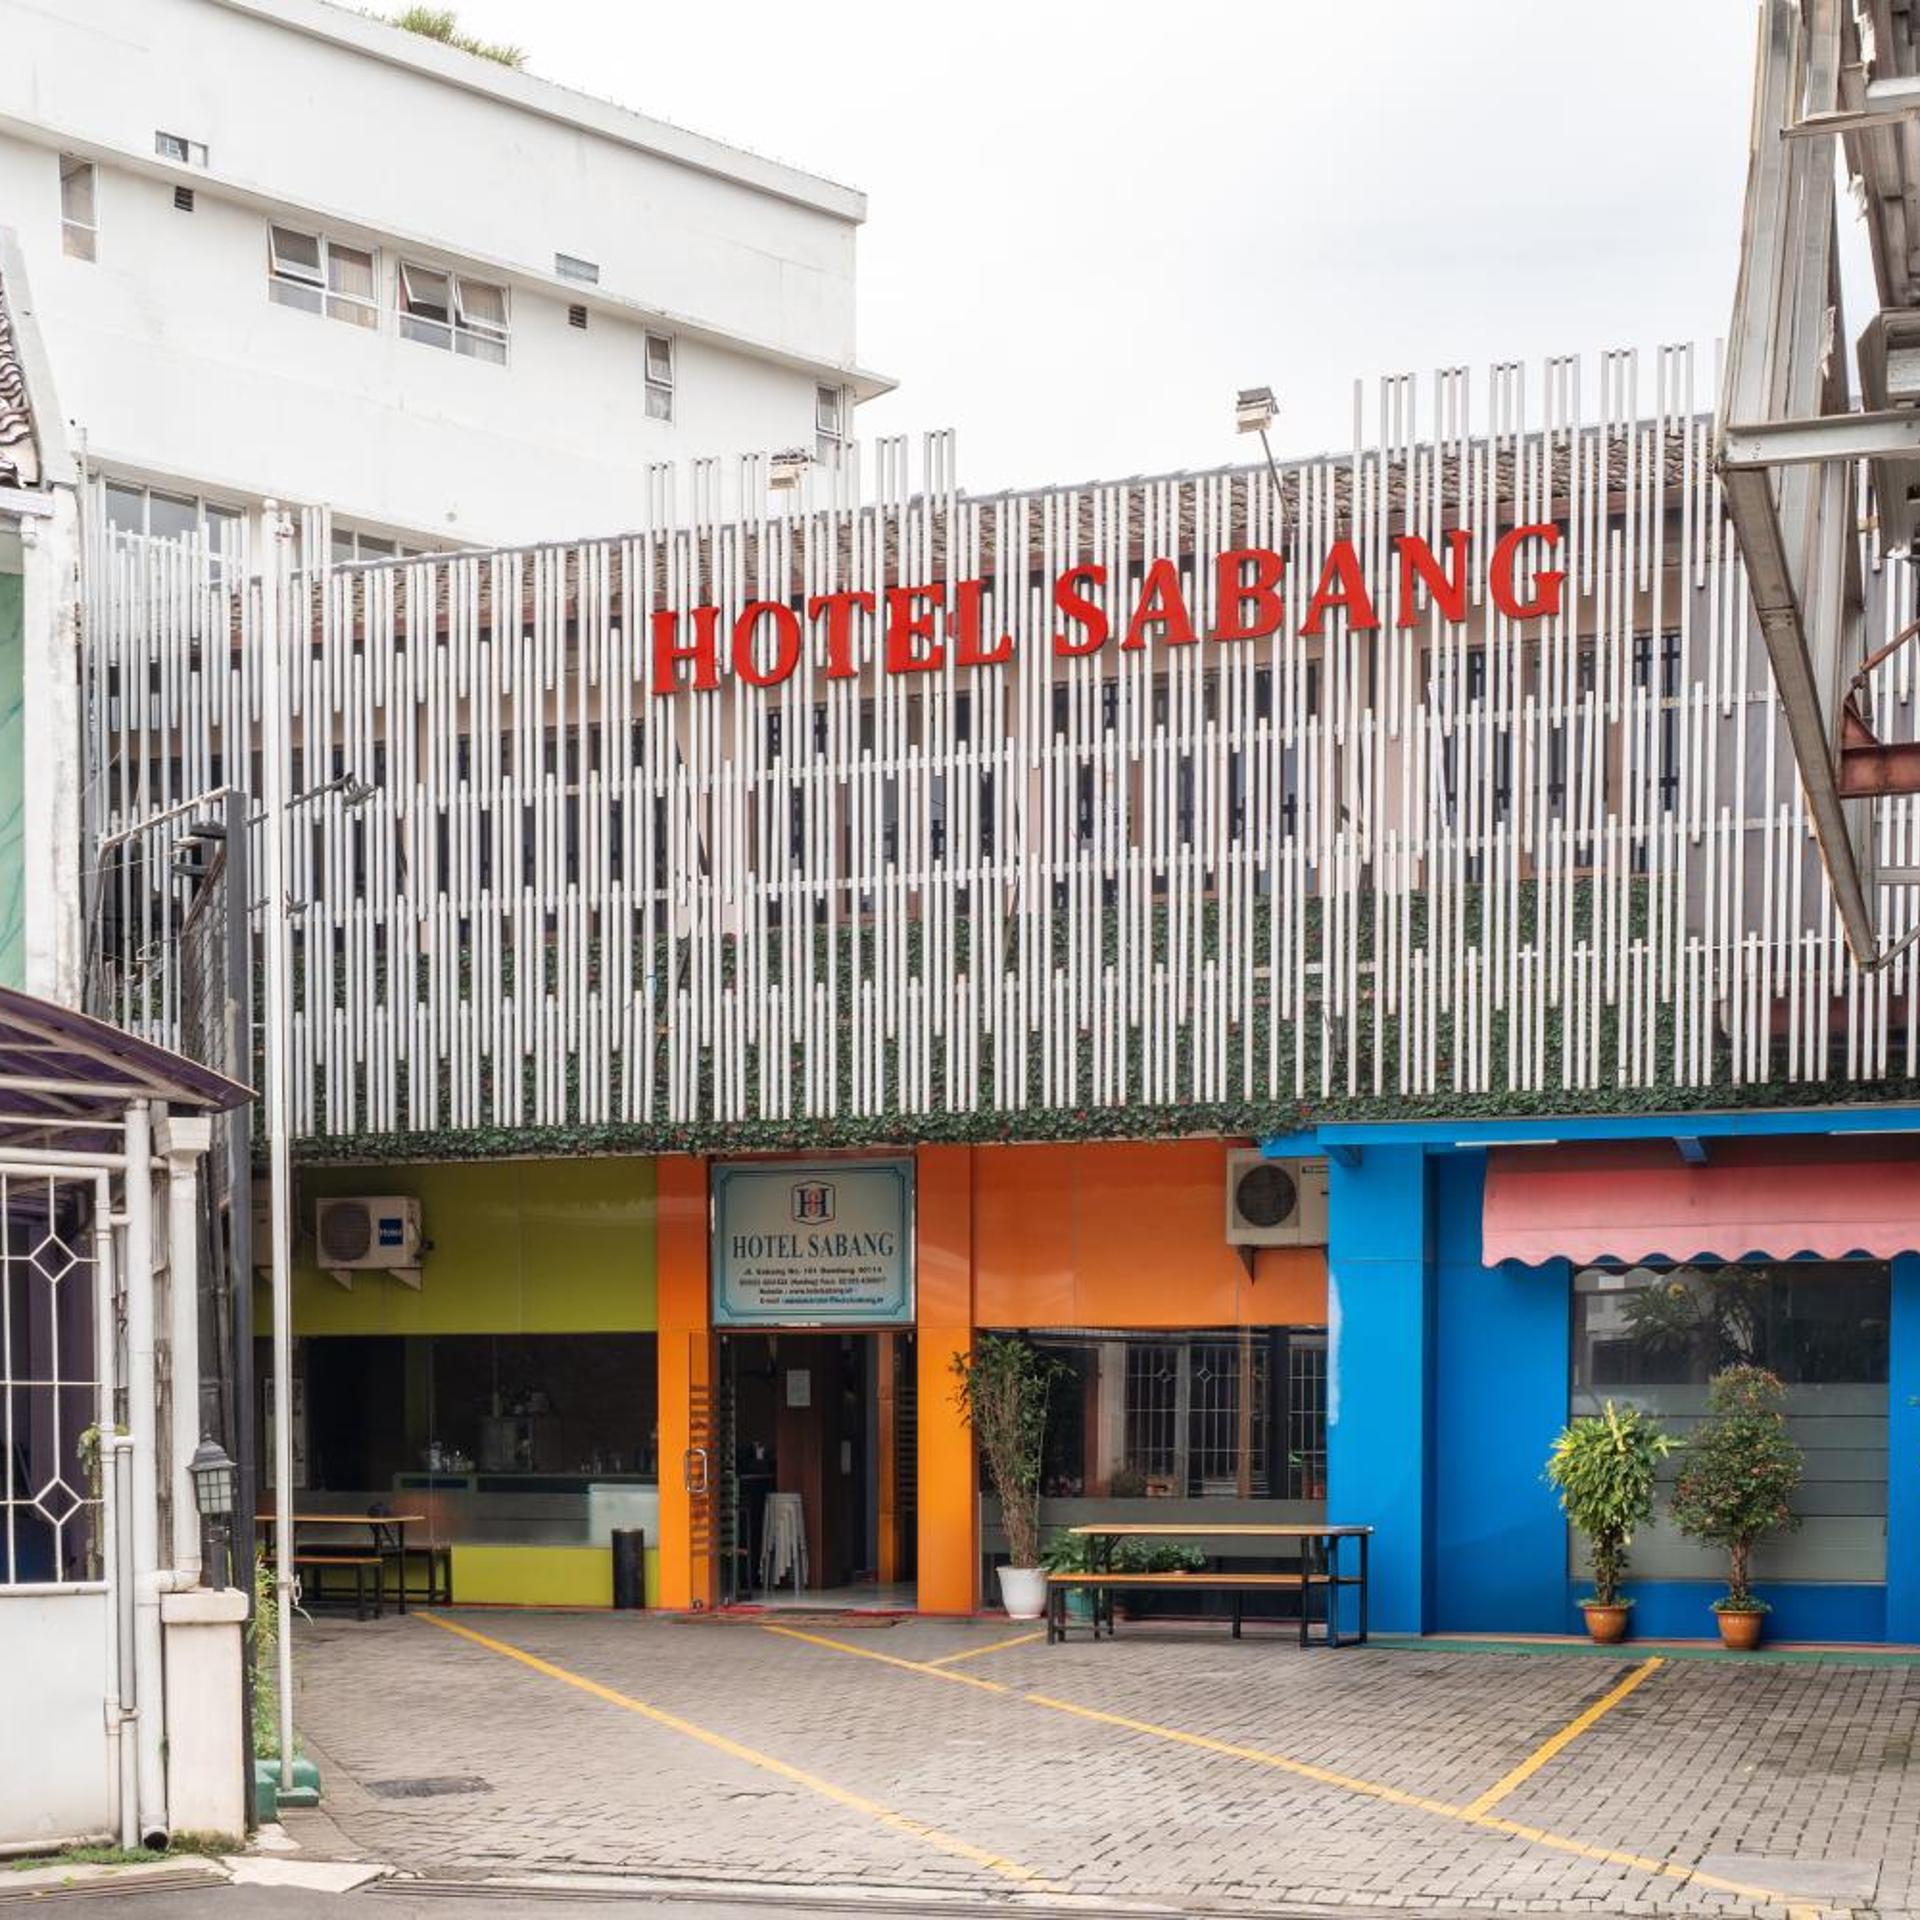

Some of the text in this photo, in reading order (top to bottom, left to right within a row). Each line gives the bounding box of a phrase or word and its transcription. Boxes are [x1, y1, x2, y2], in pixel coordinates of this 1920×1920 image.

[650, 523, 1568, 695] HOTEL SABANG
[732, 1231, 894, 1259] HOTEL SABANG
